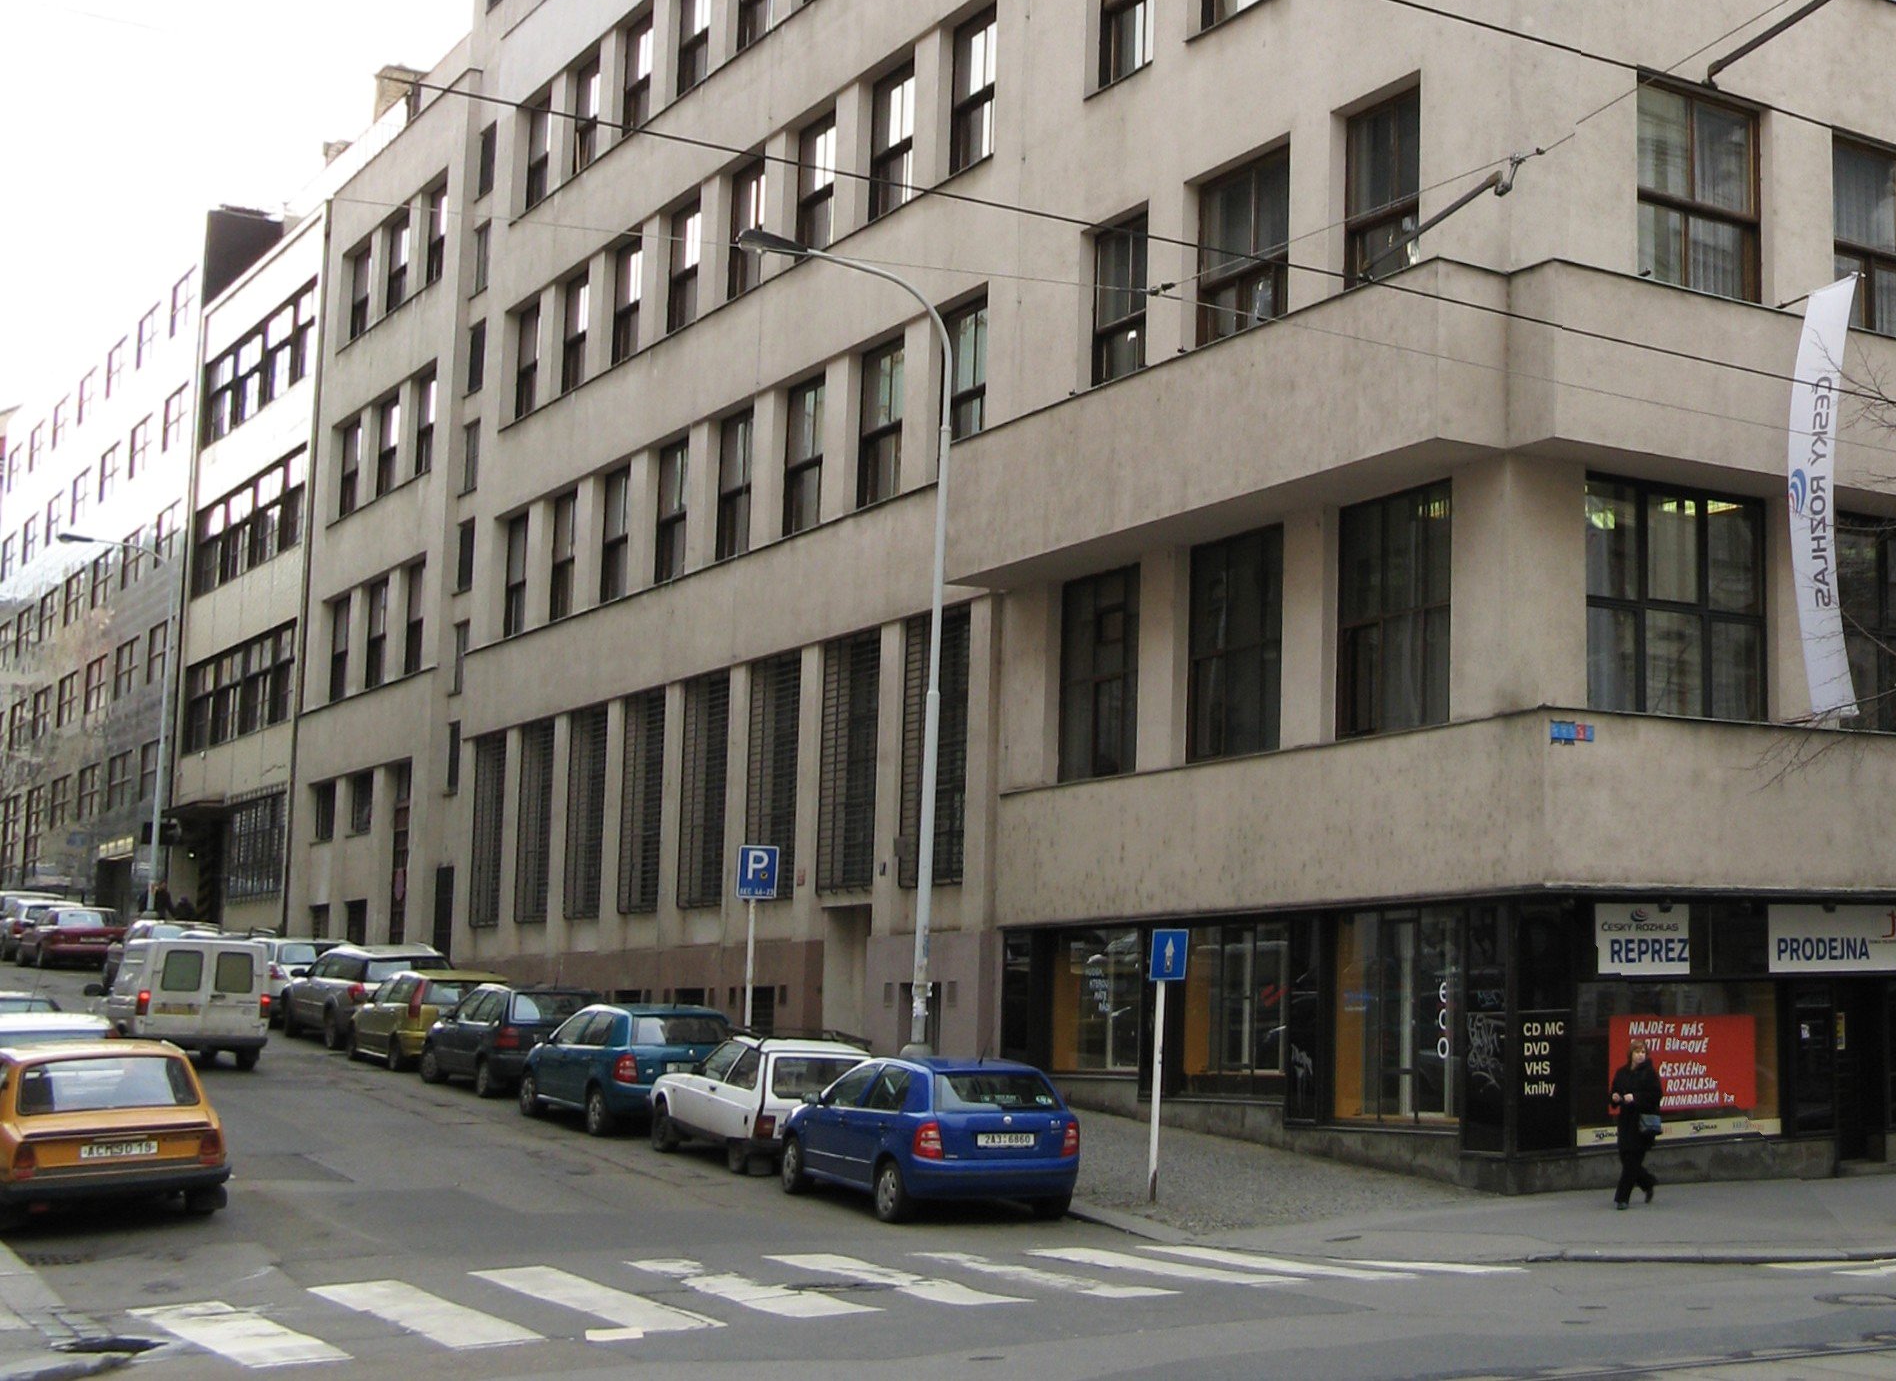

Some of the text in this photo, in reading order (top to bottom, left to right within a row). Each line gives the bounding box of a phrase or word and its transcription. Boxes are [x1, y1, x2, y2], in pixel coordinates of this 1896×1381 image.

[747, 850, 769, 880] P
[1601, 920, 1680, 932] ČESKÝ ROZHLAS
[1610, 937, 1689, 964] REPREZ
[1776, 937, 1870, 962] PRODEJNA
[1523, 1021, 1565, 1037] CD MC
[1680, 1020, 1704, 1037] NÁS
[1523, 1041, 1550, 1056] DVD
[1524, 1060, 1551, 1076] VHS
[1524, 1082, 1555, 1098] knihy
[985, 1134, 1001, 1144] 2A3
